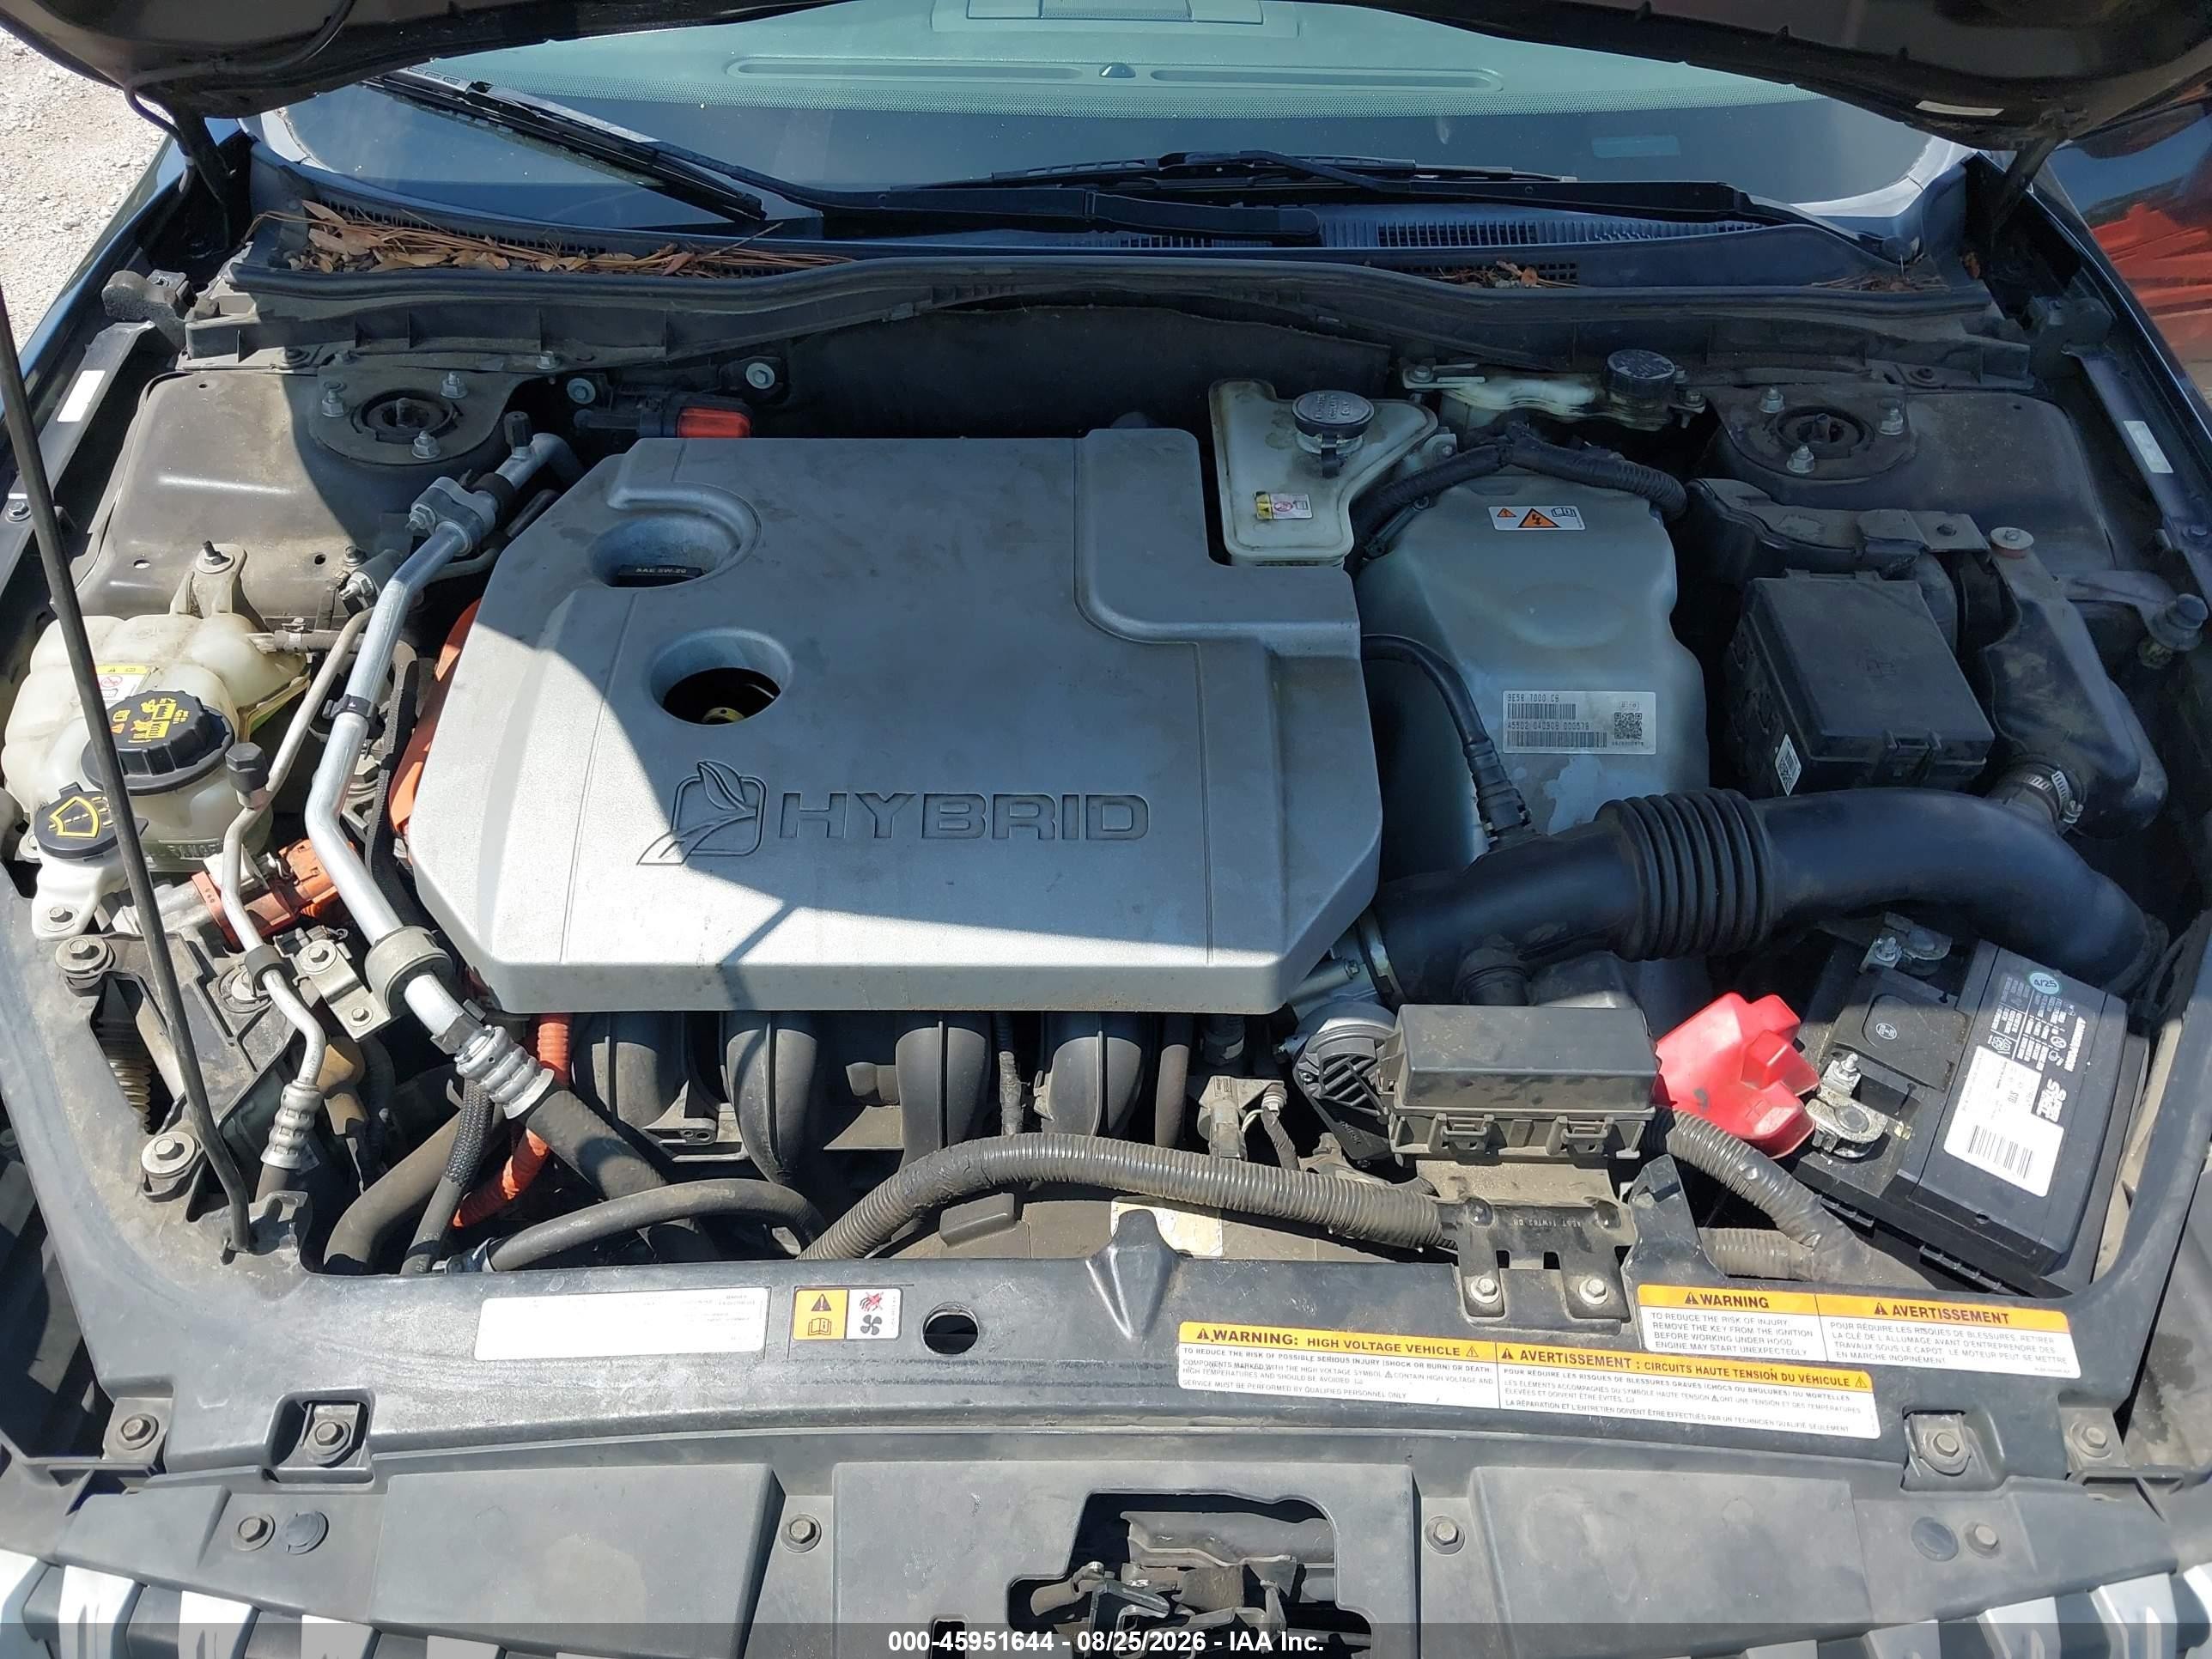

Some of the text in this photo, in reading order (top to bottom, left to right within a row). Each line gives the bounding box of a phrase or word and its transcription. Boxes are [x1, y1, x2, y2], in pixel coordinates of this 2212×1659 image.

[779, 792, 1150, 840] HYBRID
[1699, 1293, 1769, 1308] WARNING
[1650, 1311, 1662, 1320] TO
[1664, 1312, 1700, 1322] REDUCE
[1721, 1316, 1740, 1324] RISK
[1742, 1316, 1755, 1325] OF
[1890, 1304, 2010, 1324] AVERTISSEMENT
[1651, 1321, 1689, 1330] REMOVE
[1709, 1324, 1727, 1333] KEY
[1729, 1325, 1754, 1334] FROM
[1756, 1327, 1773, 1335] THE
[1774, 1328, 1814, 1337] IGNITION
[1829, 1321, 1854, 1330] POUR
[1894, 1325, 1912, 1334] LES
[1913, 1327, 1952, 1337] RISQUES
[1952, 1329, 1965, 1338] DE
[1212, 1328, 1461, 1356] WARNING: HIGH VOLTAGE VEHICLE
[1653, 1331, 1689, 1340] BEFORE
[1690, 1333, 1732, 1342] WORKING
[1734, 1335, 1765, 1345] UNDER
[1831, 1330, 1844, 1339] LA
[1934, 1338, 1960, 1346] AVANT
[2039, 1345, 2055, 1353] DES
[1655, 1340, 1808, 1357] ENGINE MAY START UNEXPECTEDLY
[1833, 1340, 1873, 1350] TRAVAUX
[1874, 1342, 1898, 1352] SOUS
[1948, 1347, 1959, 1356] LE
[1960, 1348, 1996, 1358] MOTEUR
[1998, 1351, 2020, 1360] PEUT
[2021, 1352, 2031, 1361] SE
[2033, 1353, 2067, 1364] METTRE
[1835, 1350, 1848, 1358] EN
[1849, 1351, 1886, 1361] MARCHE
[1194, 1347, 1225, 1357] REDUCE
[1228, 1349, 1243, 1358] THE
[1245, 1350, 1264, 1358] RISK
[1277, 1352, 1314, 1362] POSSIBLE
[1316, 1355, 1350, 1364] SERIOUS
[1352, 1357, 1380, 1366] INJURY
[1382, 1358, 1411, 1368] (SHOCK
[1425, 1362, 1450, 1370] BURN)
[1451, 1363, 1463, 1371] OR
[1518, 1348, 1632, 1370] AVERTISSEMENT
[1644, 1360, 1692, 1373] CIRCUITS
[1694, 1364, 1730, 1376] HAUTE
[1732, 1368, 1778, 1381] TENSION
[1780, 1372, 1796, 1382] DU
[1182, 1358, 1232, 1368] COMPONENTS
[1233, 1361, 1264, 1370] MARKED
[1266, 1363, 1283, 1371] WITH
[1299, 1365, 1318, 1374] HIGH
[1319, 1366, 1352, 1376] VOLTAGE
[1353, 1369, 1381, 1377] SYMBOL
[1393, 1371, 1425, 1381] CONTAIN
[1425, 1373, 1443, 1382] HIGH
[1445, 1375, 1476, 1383] VOLTAGE
[1478, 1376, 1494, 1385] AND
[1182, 1365, 1200, 1375] HIGH
[1202, 1366, 1258, 1378] TEMPERATURES
[1260, 1370, 1274, 1379] AND
[1276, 1371, 1305, 1381] SHOULD
[1307, 1373, 1316, 1382] BE
[1182, 1378, 1212, 1387] SERVICE
[1213, 1380, 1233, 1389] MUST
[1236, 1381, 1244, 1389] BE
[1246, 1382, 1291, 1392] PERFORMED
[1304, 1386, 1341, 1395] QUALIFIED
[1342, 1388, 1385, 1398] PERSONNEL
[1578, 1373, 1612, 1382] RISQUES
[1626, 1376, 1670, 1387] BLESSURES
[1671, 1381, 1702, 1389] GRAVES
[1622, 1388, 1654, 1397] SYMBOLE
[1656, 1390, 1678, 1399] HAUTE
[1680, 1393, 1710, 1401] TENSION
[1616, 1407, 1645, 1416] DOIVENT
